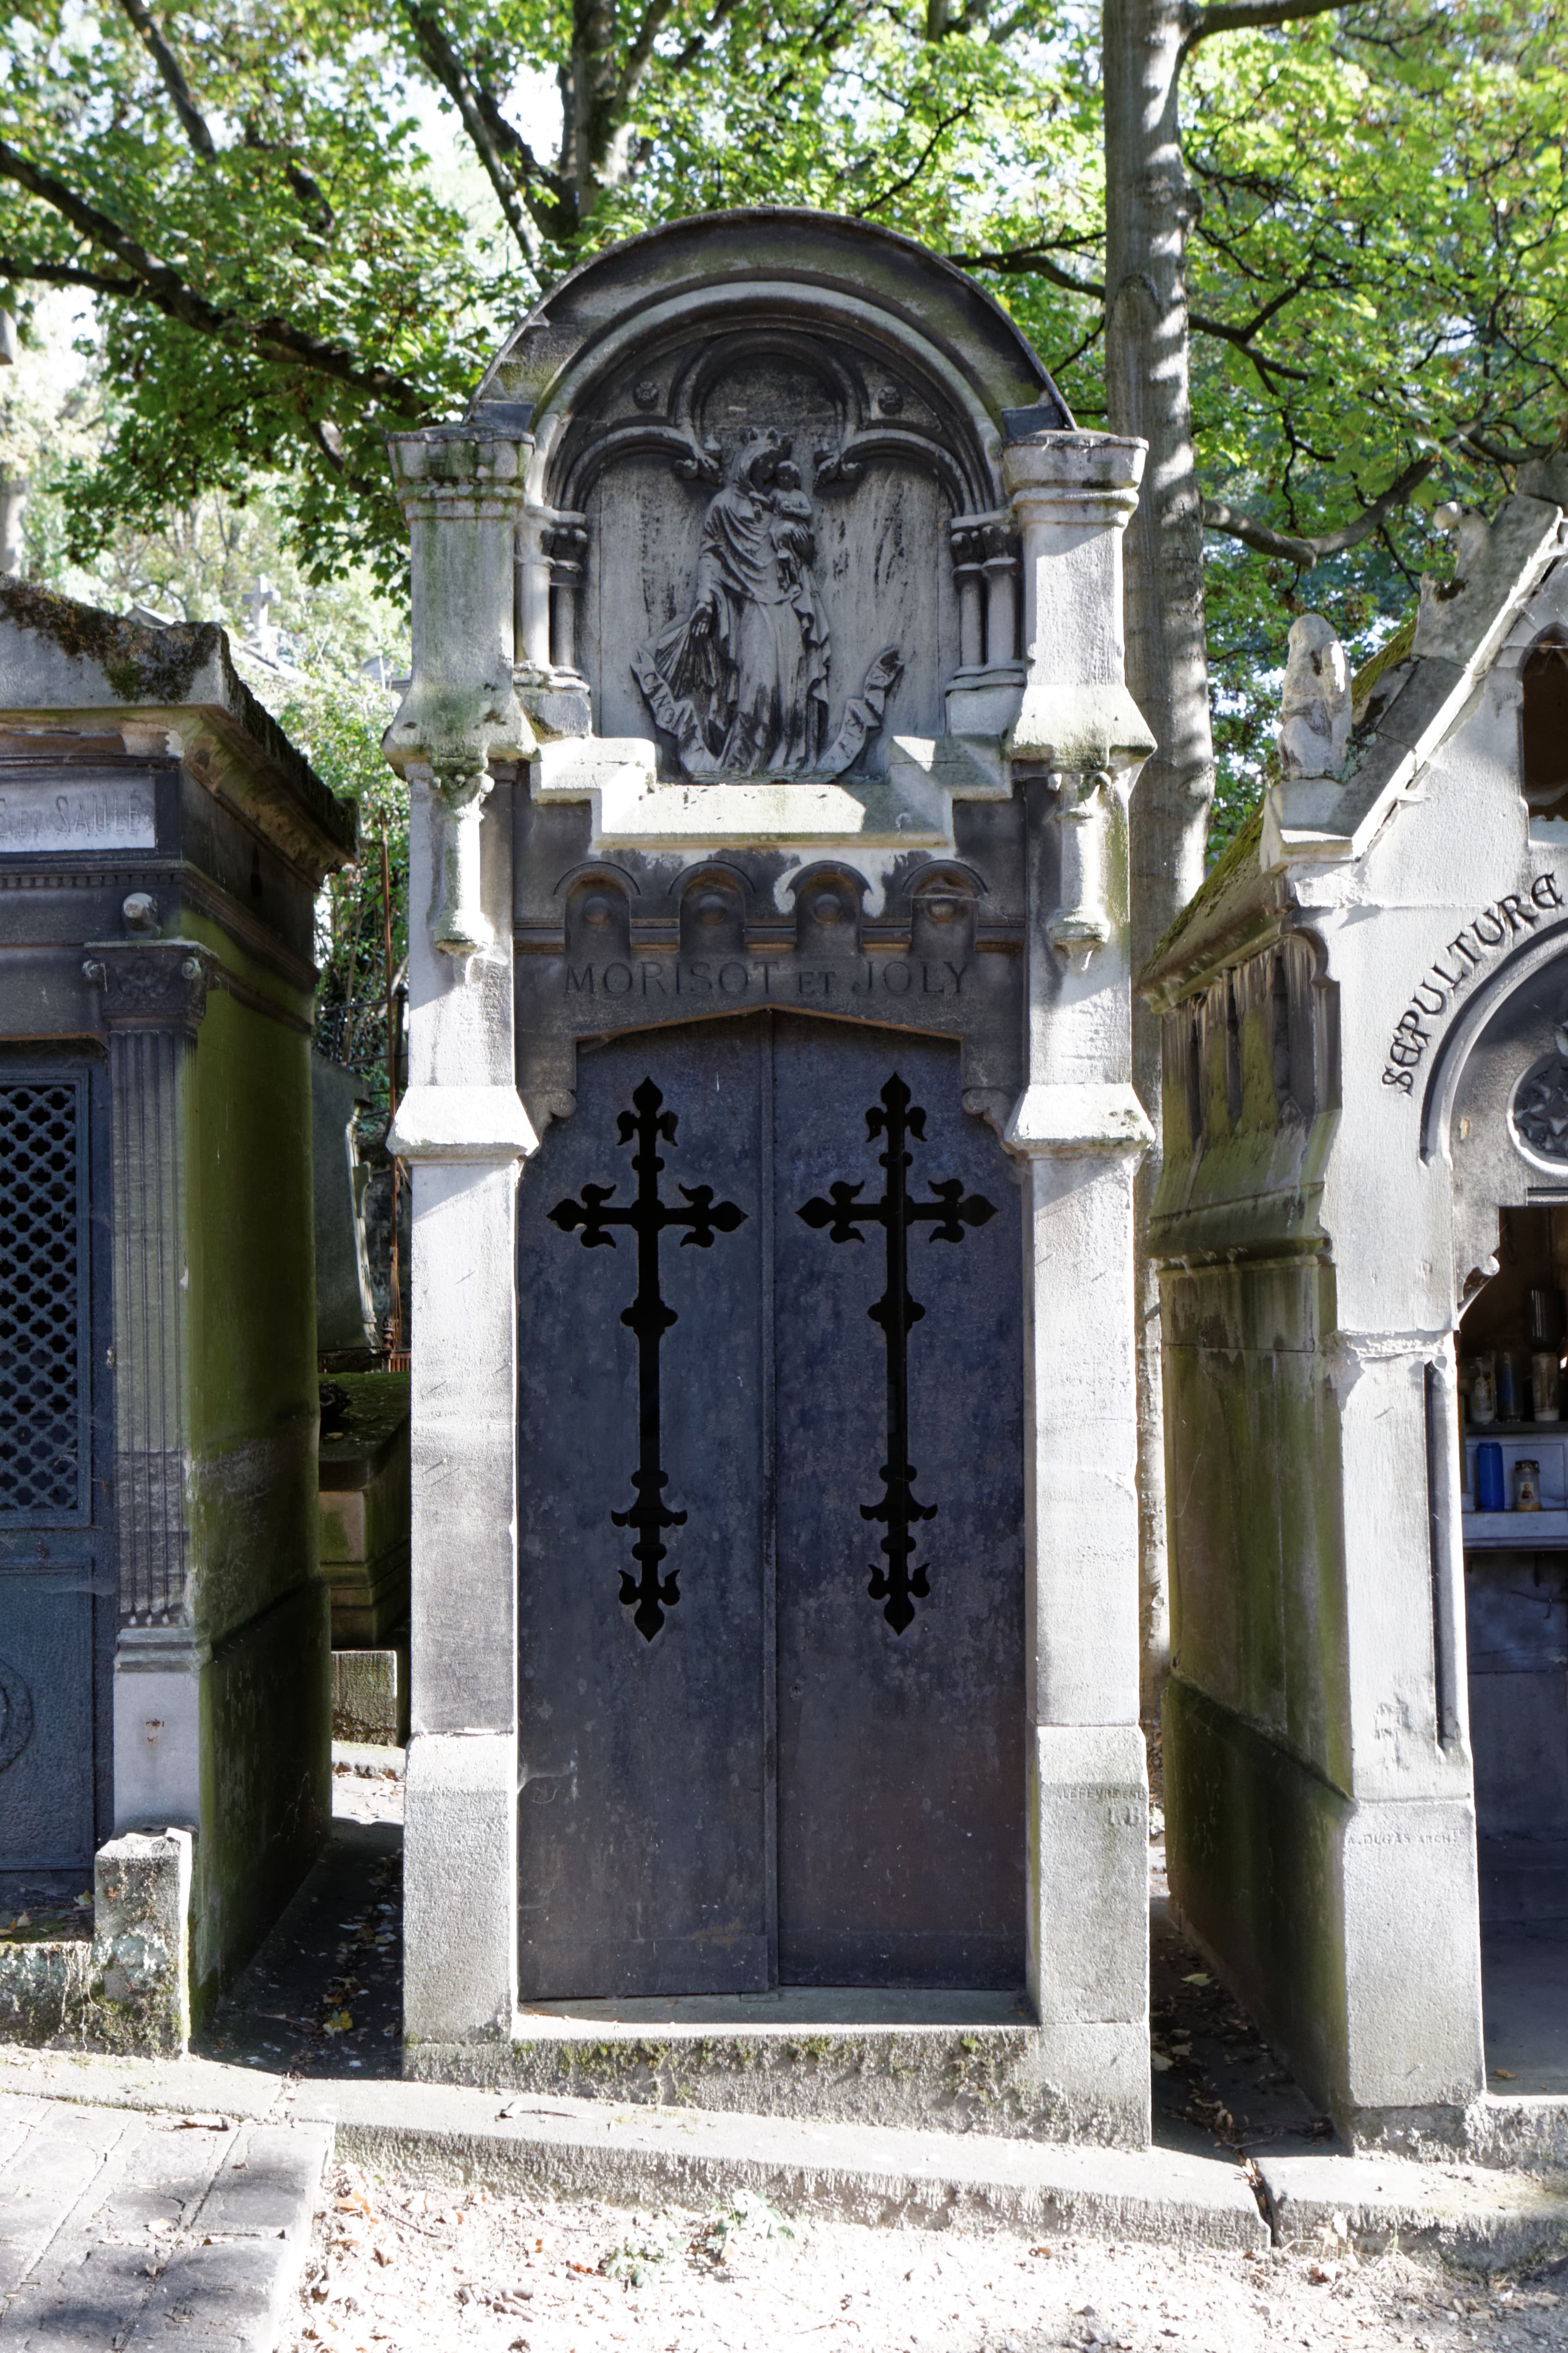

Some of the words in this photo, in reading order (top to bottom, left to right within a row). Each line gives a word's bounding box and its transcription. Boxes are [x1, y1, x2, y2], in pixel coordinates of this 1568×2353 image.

[565, 961, 779, 996] MORISOT
[797, 971, 837, 995] ET
[852, 961, 969, 995] JOLY
[1382, 872, 1565, 1097] SEPULTURE
